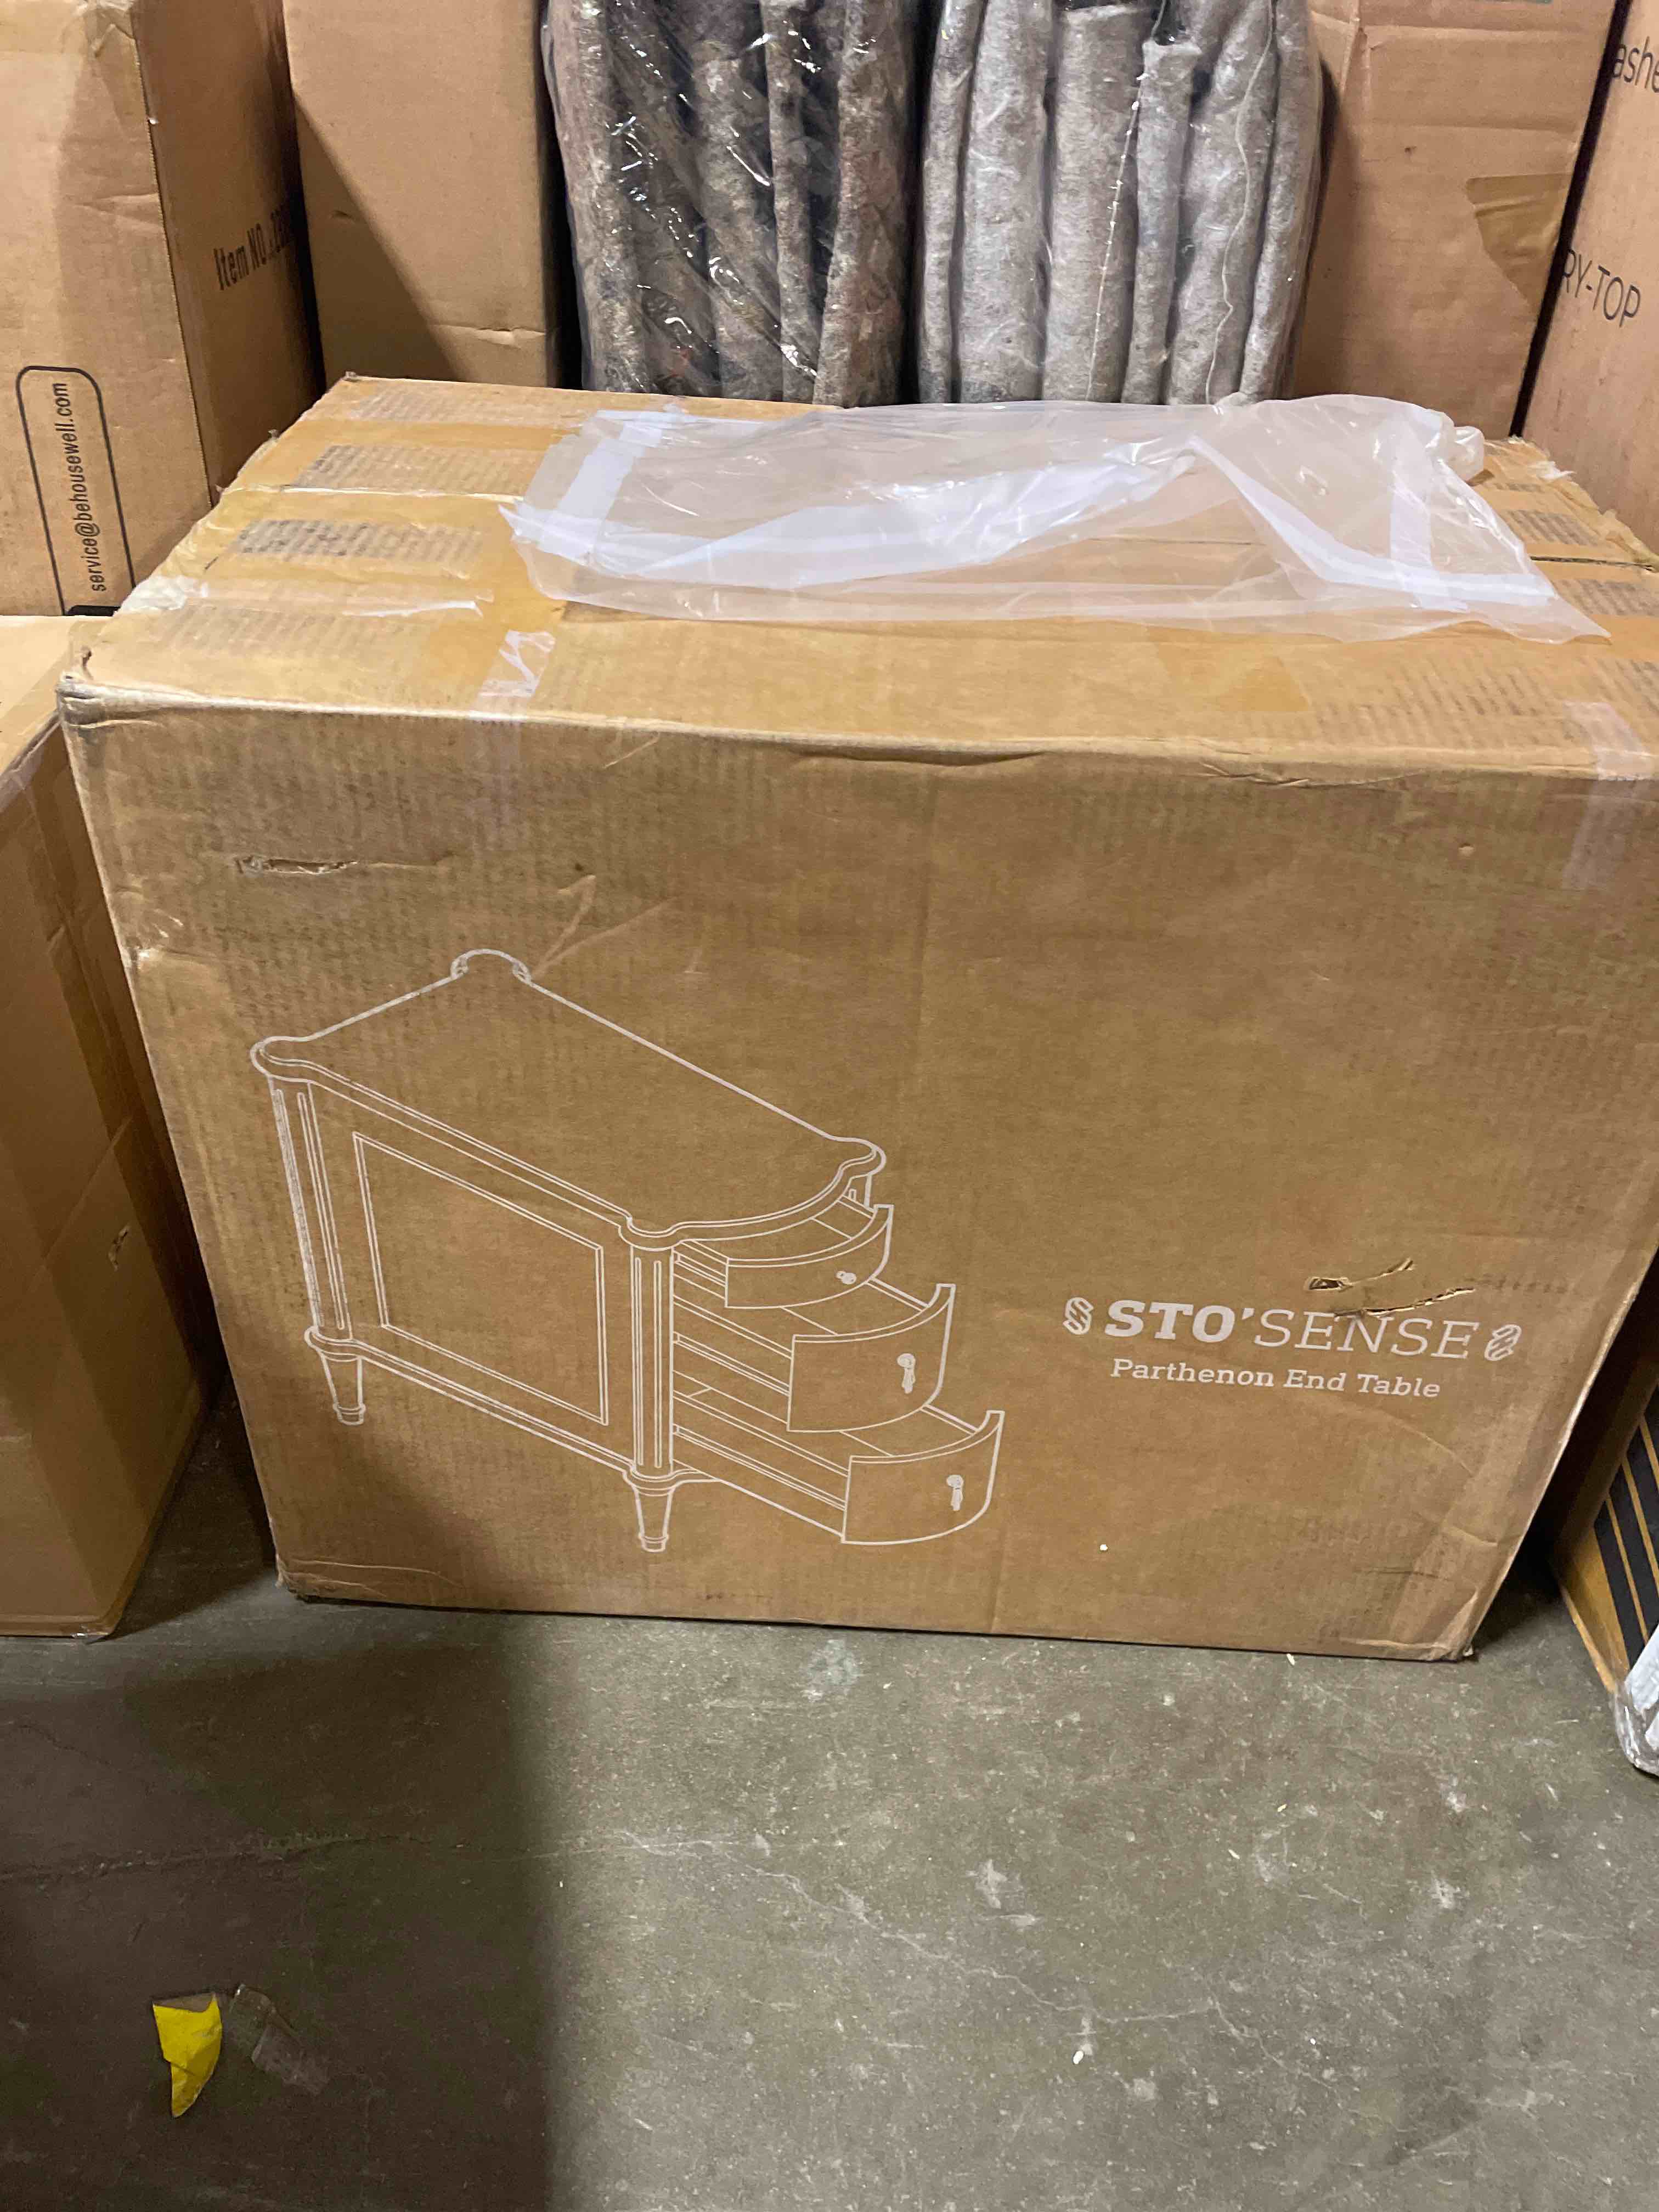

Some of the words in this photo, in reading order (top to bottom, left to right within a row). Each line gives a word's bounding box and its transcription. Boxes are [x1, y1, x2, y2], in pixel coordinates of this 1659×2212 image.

[213, 248, 250, 291] Item
[52, 382, 106, 591] service@behousewell.com
[1104, 1299, 1480, 1359] STO'SENSE
[1110, 1358, 1274, 1387] Parthenon
[1283, 1369, 1346, 1391] End
[1357, 1373, 1441, 1398] Table
